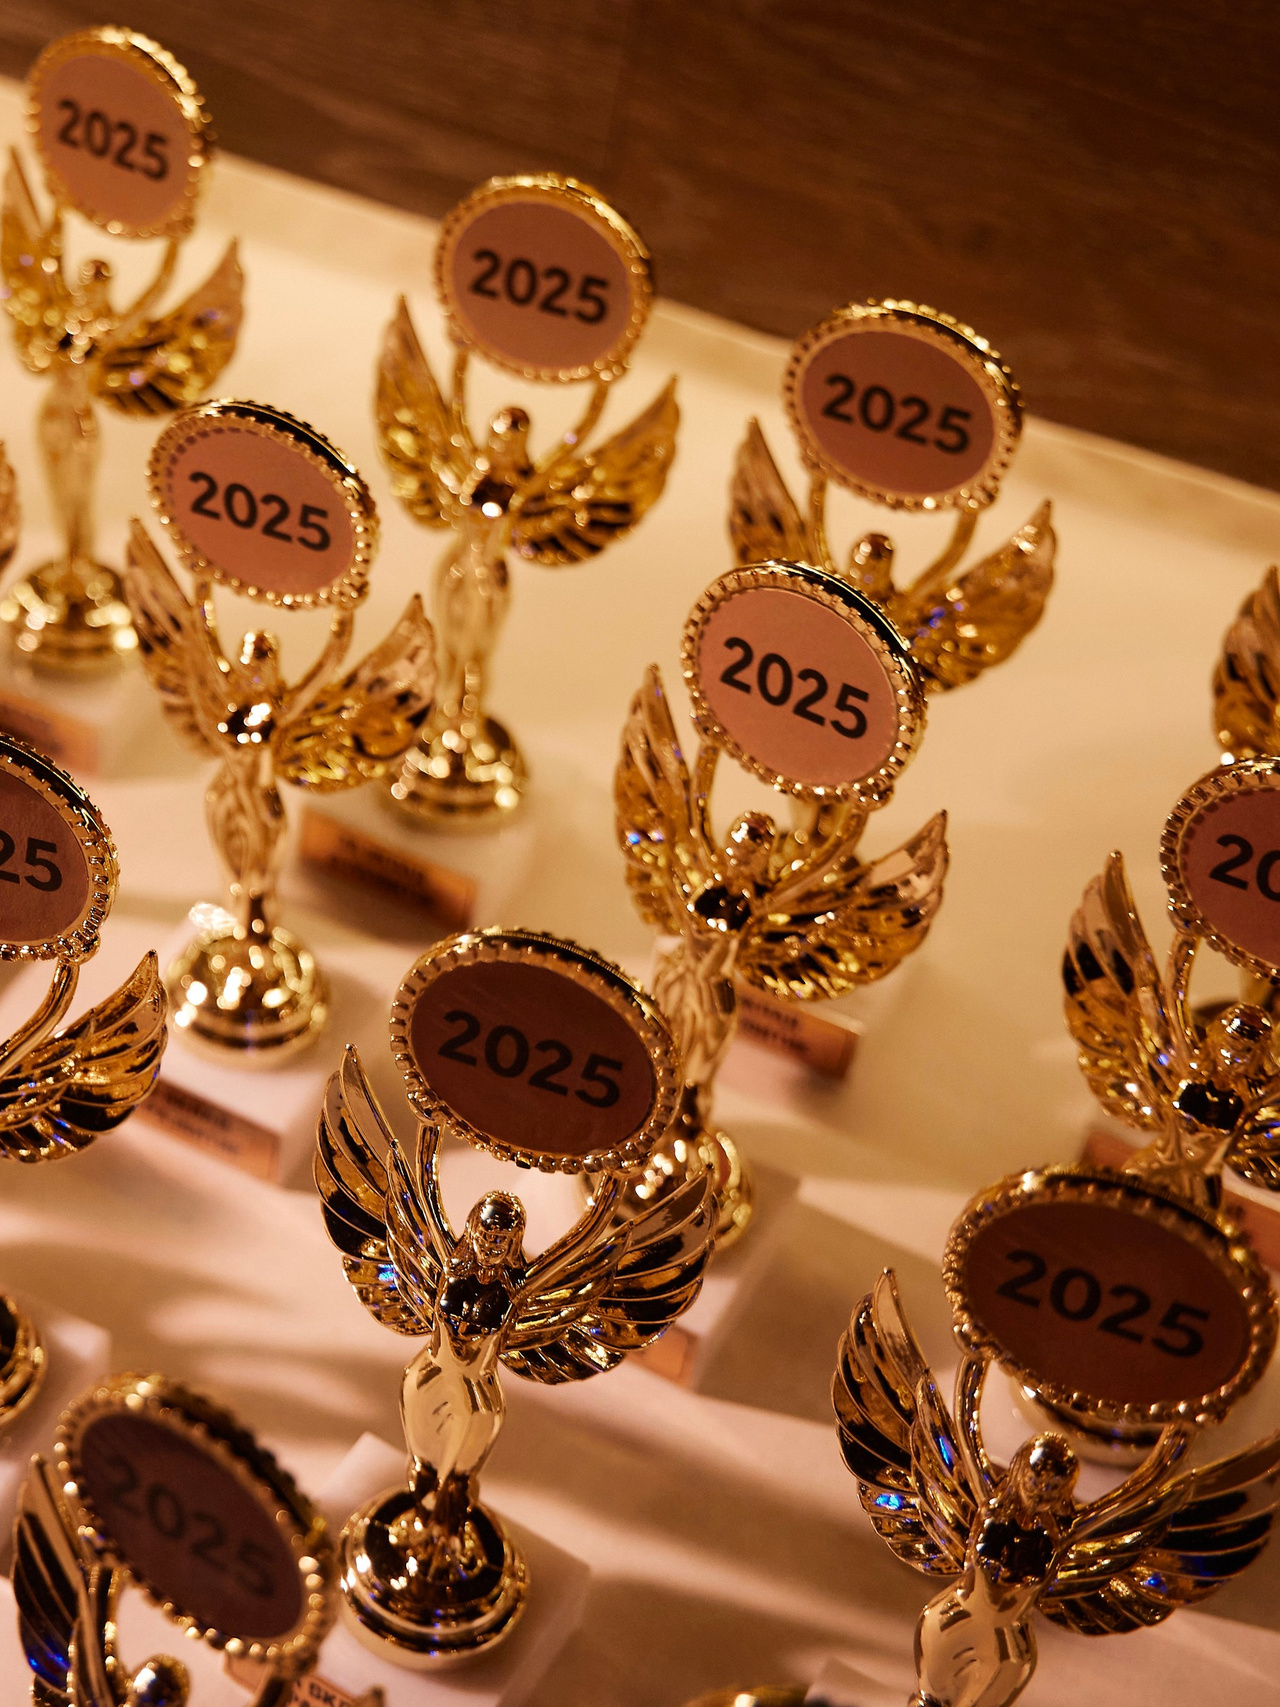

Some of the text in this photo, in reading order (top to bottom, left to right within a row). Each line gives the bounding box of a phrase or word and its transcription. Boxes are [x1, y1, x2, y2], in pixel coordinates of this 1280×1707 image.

[57, 100, 170, 181] 2025
[469, 250, 612, 325] 2025
[822, 374, 972, 455] 2025
[188, 472, 331, 552] 2025
[720, 637, 870, 741] 2025
[1209, 833, 1280, 903] 20
[438, 1009, 624, 1109] 2025
[998, 1250, 1211, 1360] 2025
[102, 1455, 275, 1598] 2025
